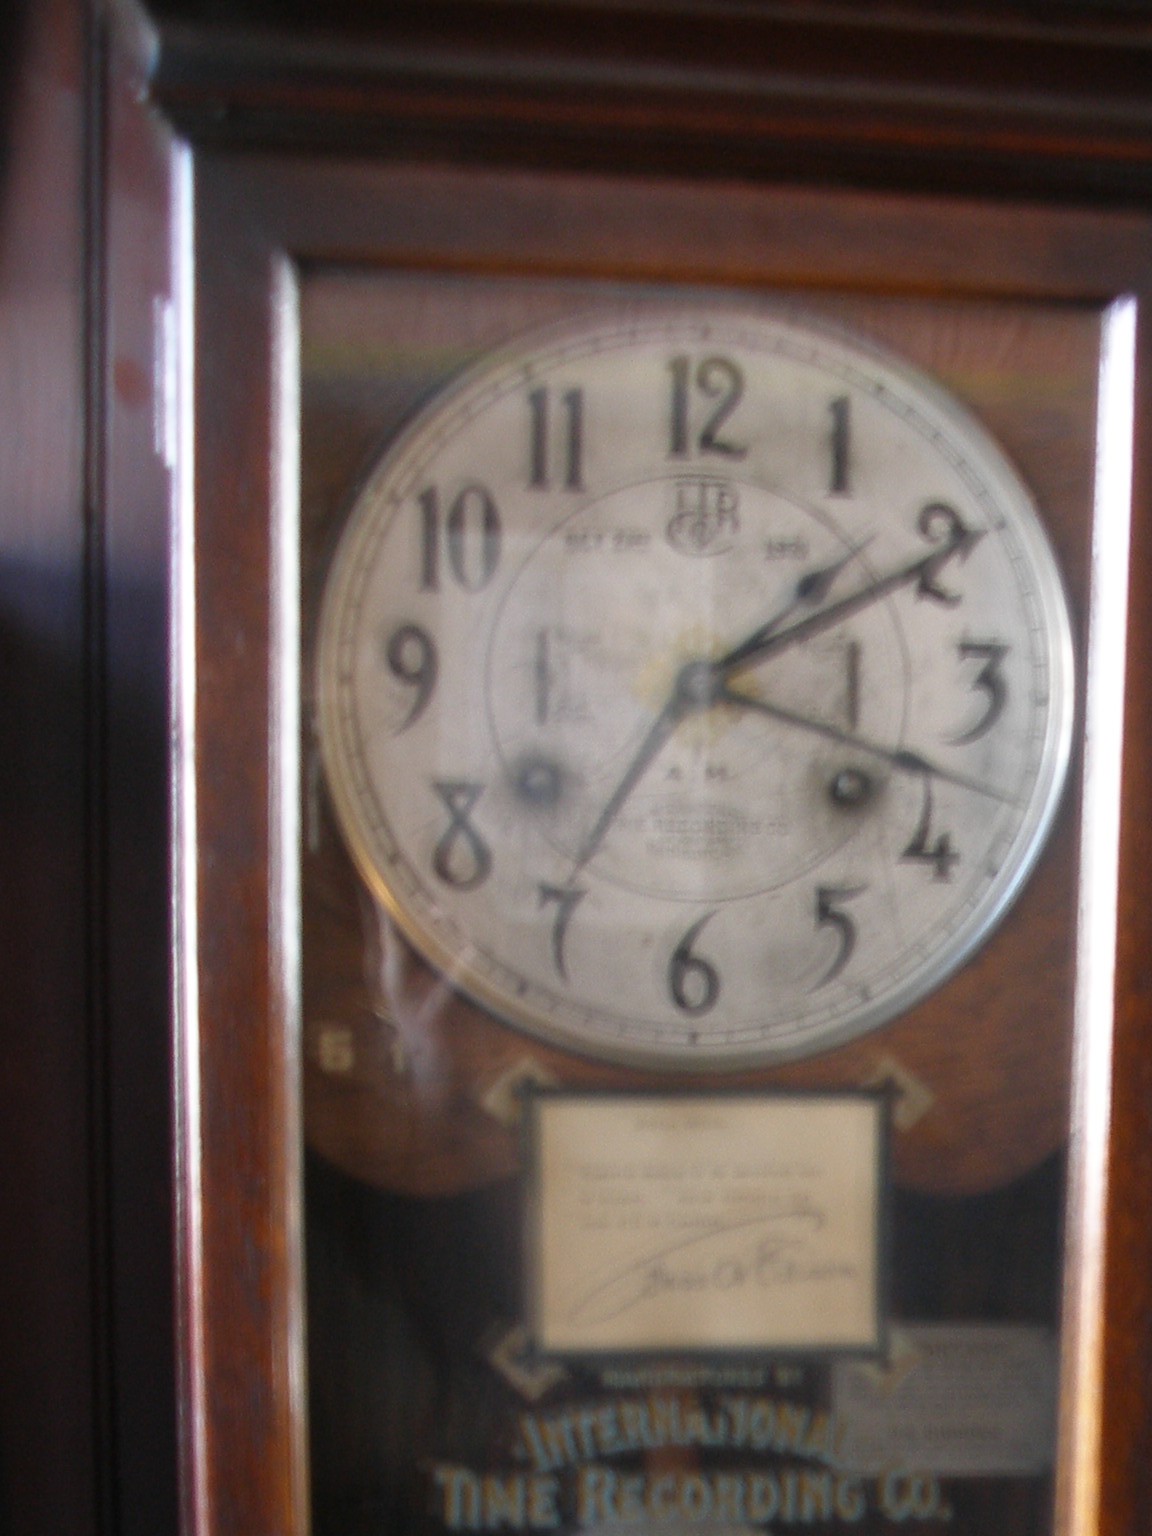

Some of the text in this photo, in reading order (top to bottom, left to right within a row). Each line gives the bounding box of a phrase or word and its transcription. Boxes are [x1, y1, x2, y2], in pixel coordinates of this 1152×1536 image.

[526, 387, 584, 491] 11
[666, 355, 748, 460] 12
[826, 397, 855, 497] 1
[418, 485, 502, 592] 10
[918, 502, 972, 605] 2
[387, 624, 440, 737] 9
[944, 643, 1009, 746] 3
[432, 780, 494, 890] 8
[898, 764, 960, 882] 4
[538, 885, 588, 983] 7
[667, 910, 721, 1016] 6
[805, 884, 868, 995] 5
[434, 1467, 561, 1529] TIME
[577, 1464, 866, 1523] RECORDING
